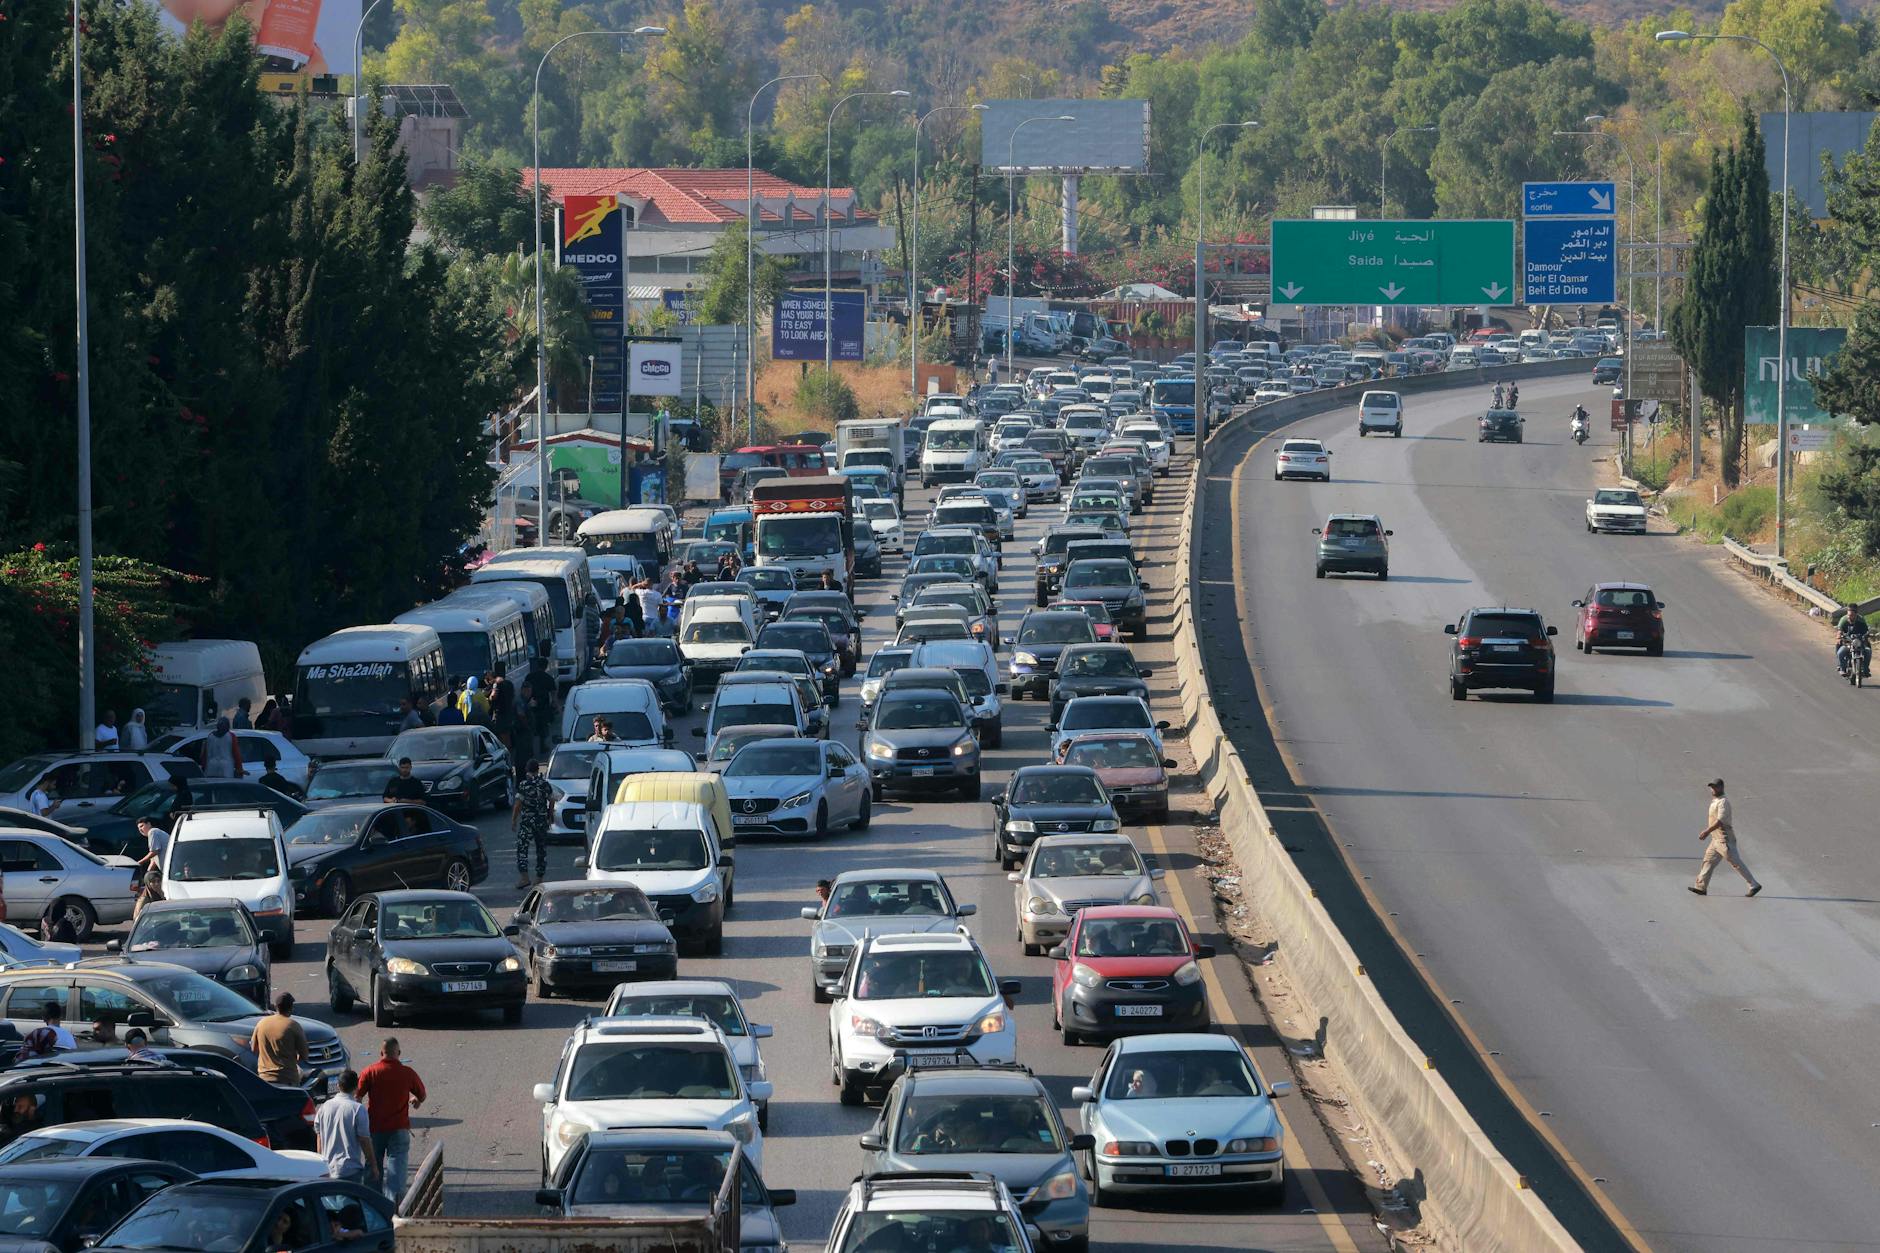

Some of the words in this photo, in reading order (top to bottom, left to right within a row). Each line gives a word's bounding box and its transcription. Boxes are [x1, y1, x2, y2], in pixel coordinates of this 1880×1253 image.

[1529, 188, 1558, 200] مخرج
[1530, 203, 1553, 211] sortie
[1348, 229, 1374, 243] Jiyé
[1394, 229, 1435, 245] الجية
[1571, 226, 1609, 238] الدامور
[1561, 239, 1590, 250] القمر
[1593, 240, 1608, 250] دير
[564, 254, 617, 264] MEDCO
[1348, 255, 1384, 266] Saida
[1393, 254, 1435, 269] صيدا
[1560, 251, 1586, 263] الدين
[1588, 252, 1608, 262] بيت
[1527, 262, 1563, 272] Damour
[1527, 274, 1546, 283] Deir
[1548, 274, 1557, 283] El
[1559, 274, 1589, 284] Qamar
[1528, 285, 1546, 295] Beit
[1548, 285, 1561, 295] Ed
[1563, 284, 1589, 295] Dine
[781, 300, 801, 310] WHEN
[802, 300, 835, 311] SOMEOE
[781, 310, 795, 320] HAS
[796, 311, 814, 320] YOUR
[815, 311, 836, 321] BA.
[780, 320, 793, 329] IT'S
[794, 320, 813, 330] EASY
[780, 331, 789, 340] TO
[790, 331, 809, 340] LOOK
[809, 330, 836, 341] AHEA.
[642, 361, 670, 374] chicco
[306, 666, 327, 680] Ma
[328, 662, 393, 679] Sha2allah
[1121, 1006, 1127, 1015] B
[1183, 1165, 1215, 1176] 271721
